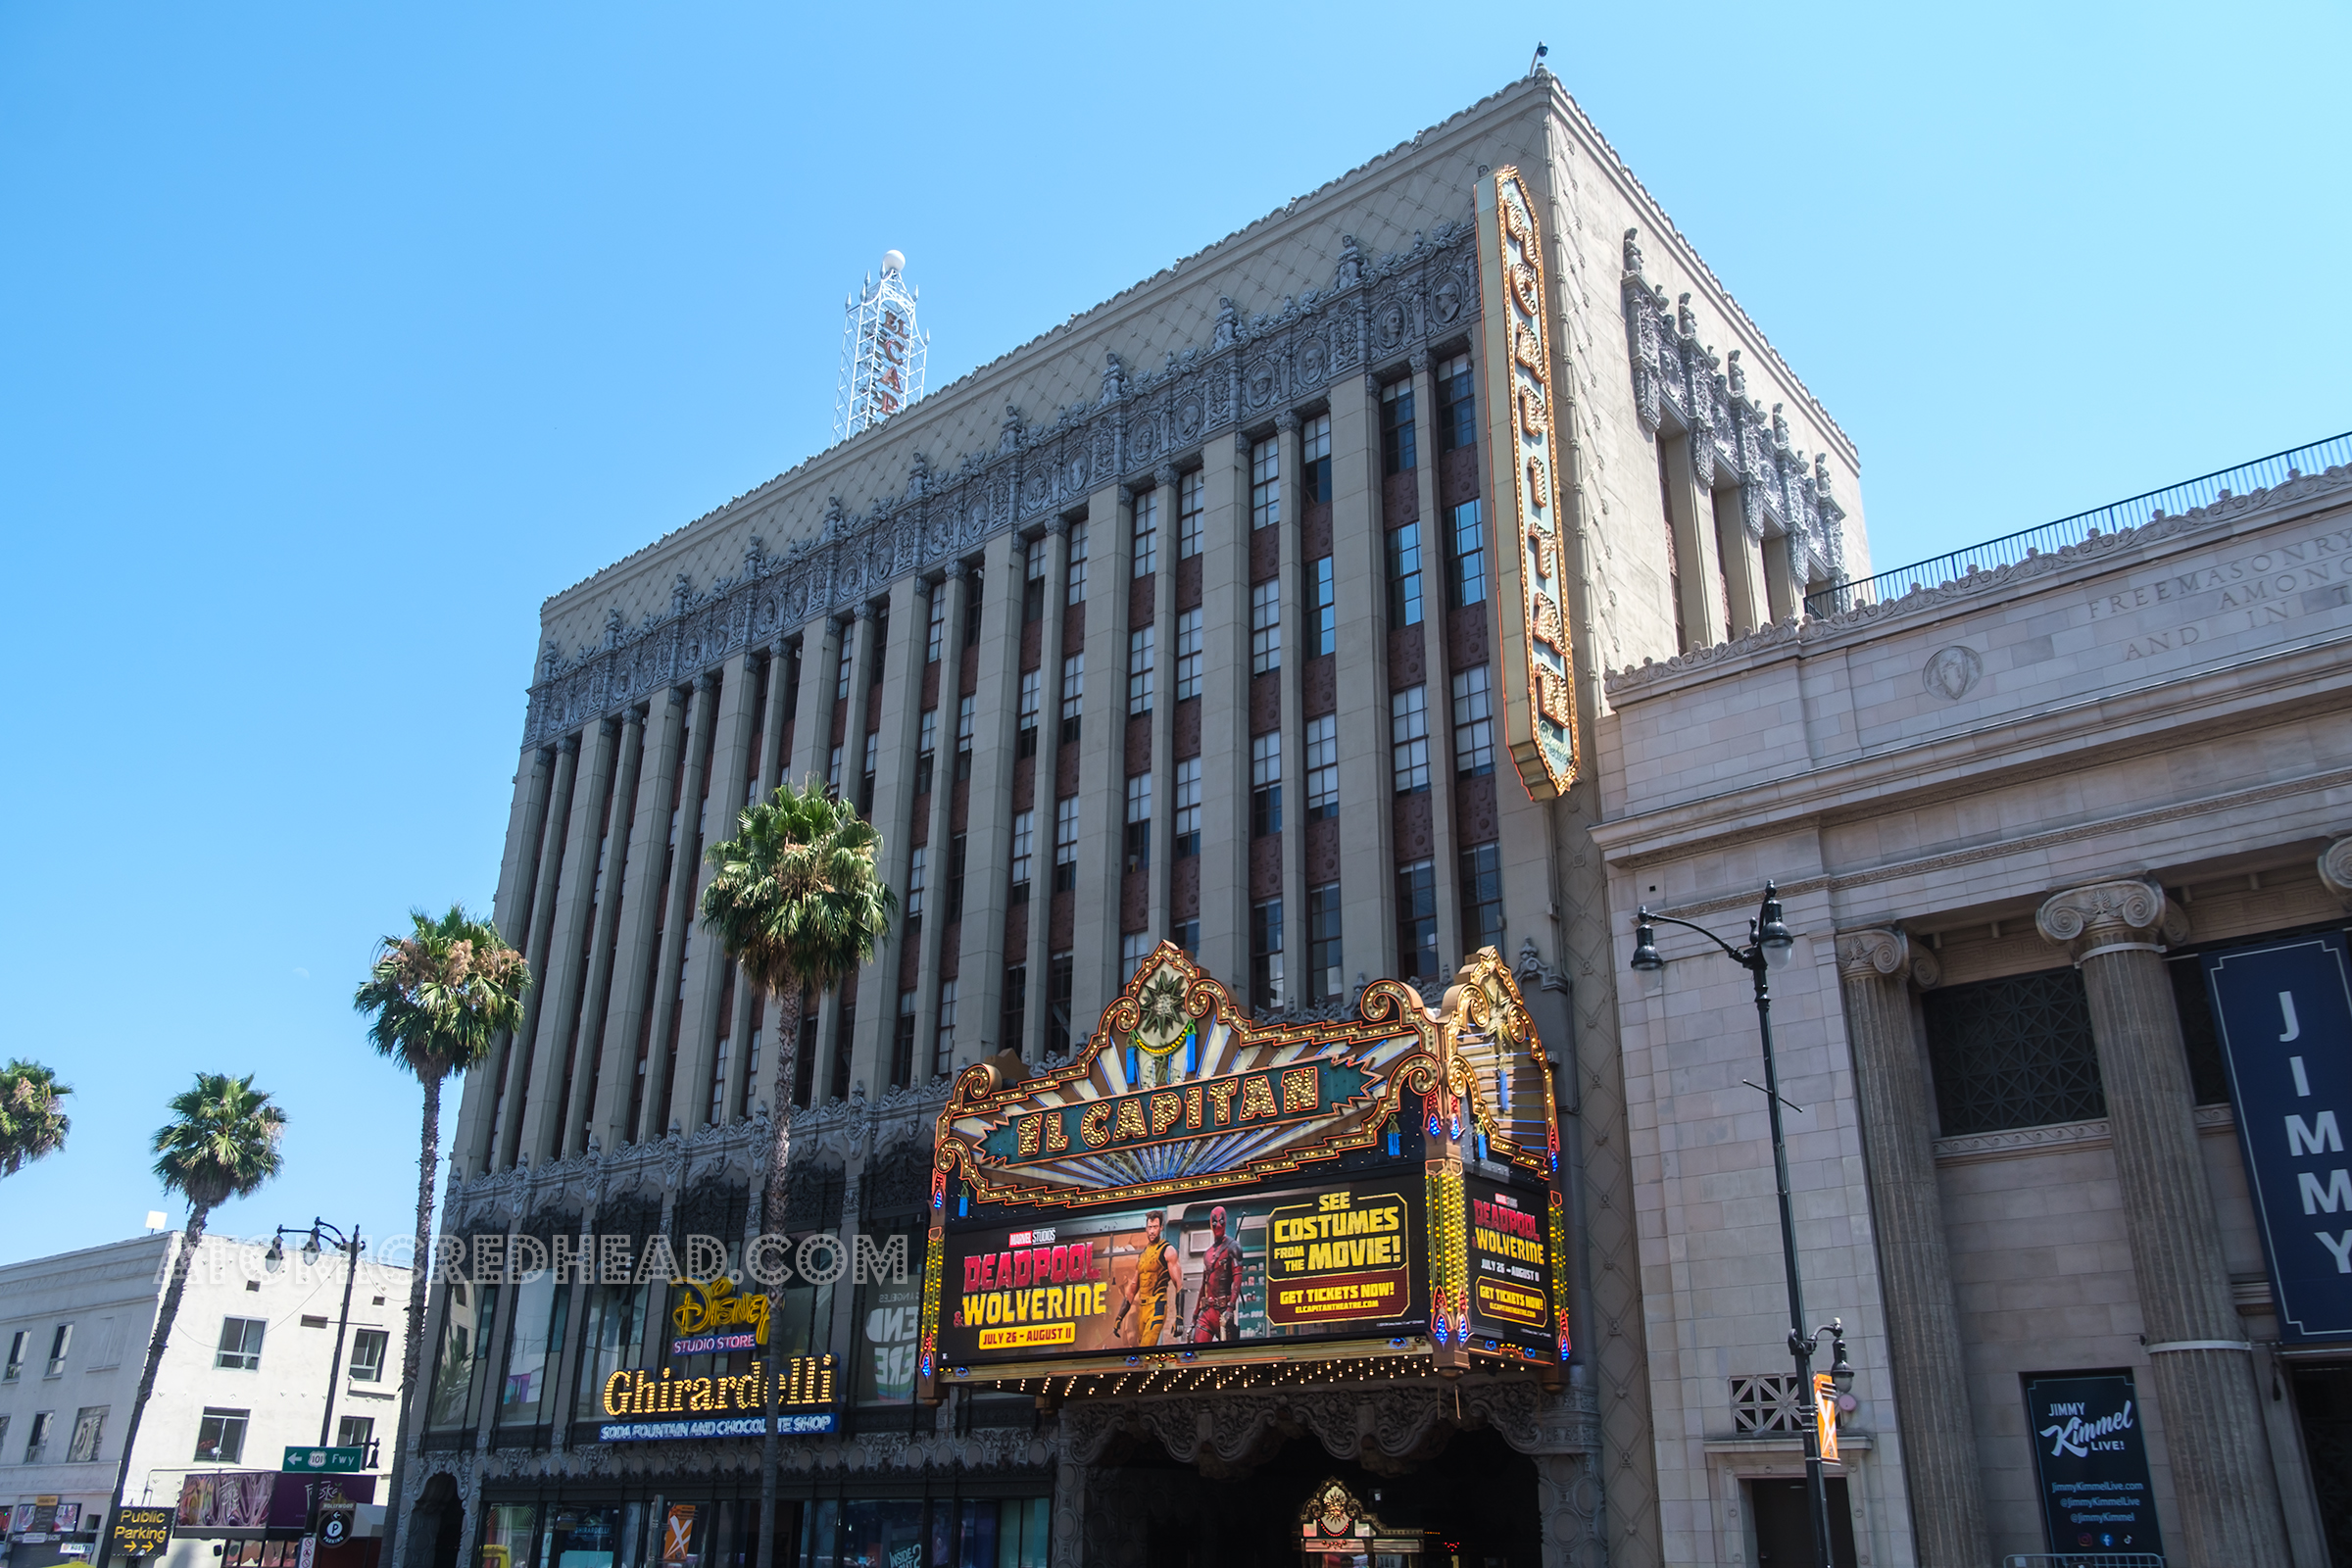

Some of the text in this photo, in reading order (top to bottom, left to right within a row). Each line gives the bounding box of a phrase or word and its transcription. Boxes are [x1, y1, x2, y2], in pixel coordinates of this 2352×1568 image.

[884, 310, 909, 339] EL
[2088, 527, 2352, 619] FREEMASONRY
[2126, 626, 2199, 661] AND
[2245, 601, 2288, 628] IN
[1015, 1065, 1320, 1156] EL CAPITAN
[2278, 991, 2352, 1274] JIMMY
[1318, 1191, 1350, 1212] SEE
[1274, 1206, 1399, 1244] COSTUMES
[1473, 1199, 1541, 1242] DEADPOOL
[1009, 1227, 1055, 1248] MARVEL STUDIOS
[1475, 1227, 1545, 1265] WOLVERINE
[1274, 1246, 1305, 1260] FROM
[1307, 1235, 1401, 1271] MOVIE!
[963, 1241, 1102, 1293] DEADPOOL
[1284, 1259, 1305, 1273] THE
[1280, 1281, 1395, 1305] GET TICKETS NOW!
[1479, 1285, 1494, 1300] GET
[1494, 1288, 1525, 1307] TICKETS
[954, 1282, 1107, 1328] & WOLVERINE
[1295, 1299, 1379, 1314] ELCAPITANTHEATRE.COM
[673, 1333, 756, 1353] STUDIO STORE
[982, 1330, 1004, 1346] JULY
[1005, 1331, 1017, 1344] 26
[1027, 1328, 1063, 1343] AUGUST
[2048, 1402, 2085, 1417] JIMMY
[600, 1415, 832, 1441] SODA FOUNTAIN AND CHOCOLTE SHOP
[2039, 1399, 2133, 1458] Kimmel
[2090, 1441, 2126, 1451] LIVE!
[310, 1453, 355, 1468] 101 Fwy
[120, 1509, 166, 1525] Public
[114, 1525, 168, 1544] Parking
[322, 1536, 344, 1544] PARKING
[331, 1523, 339, 1535] P
